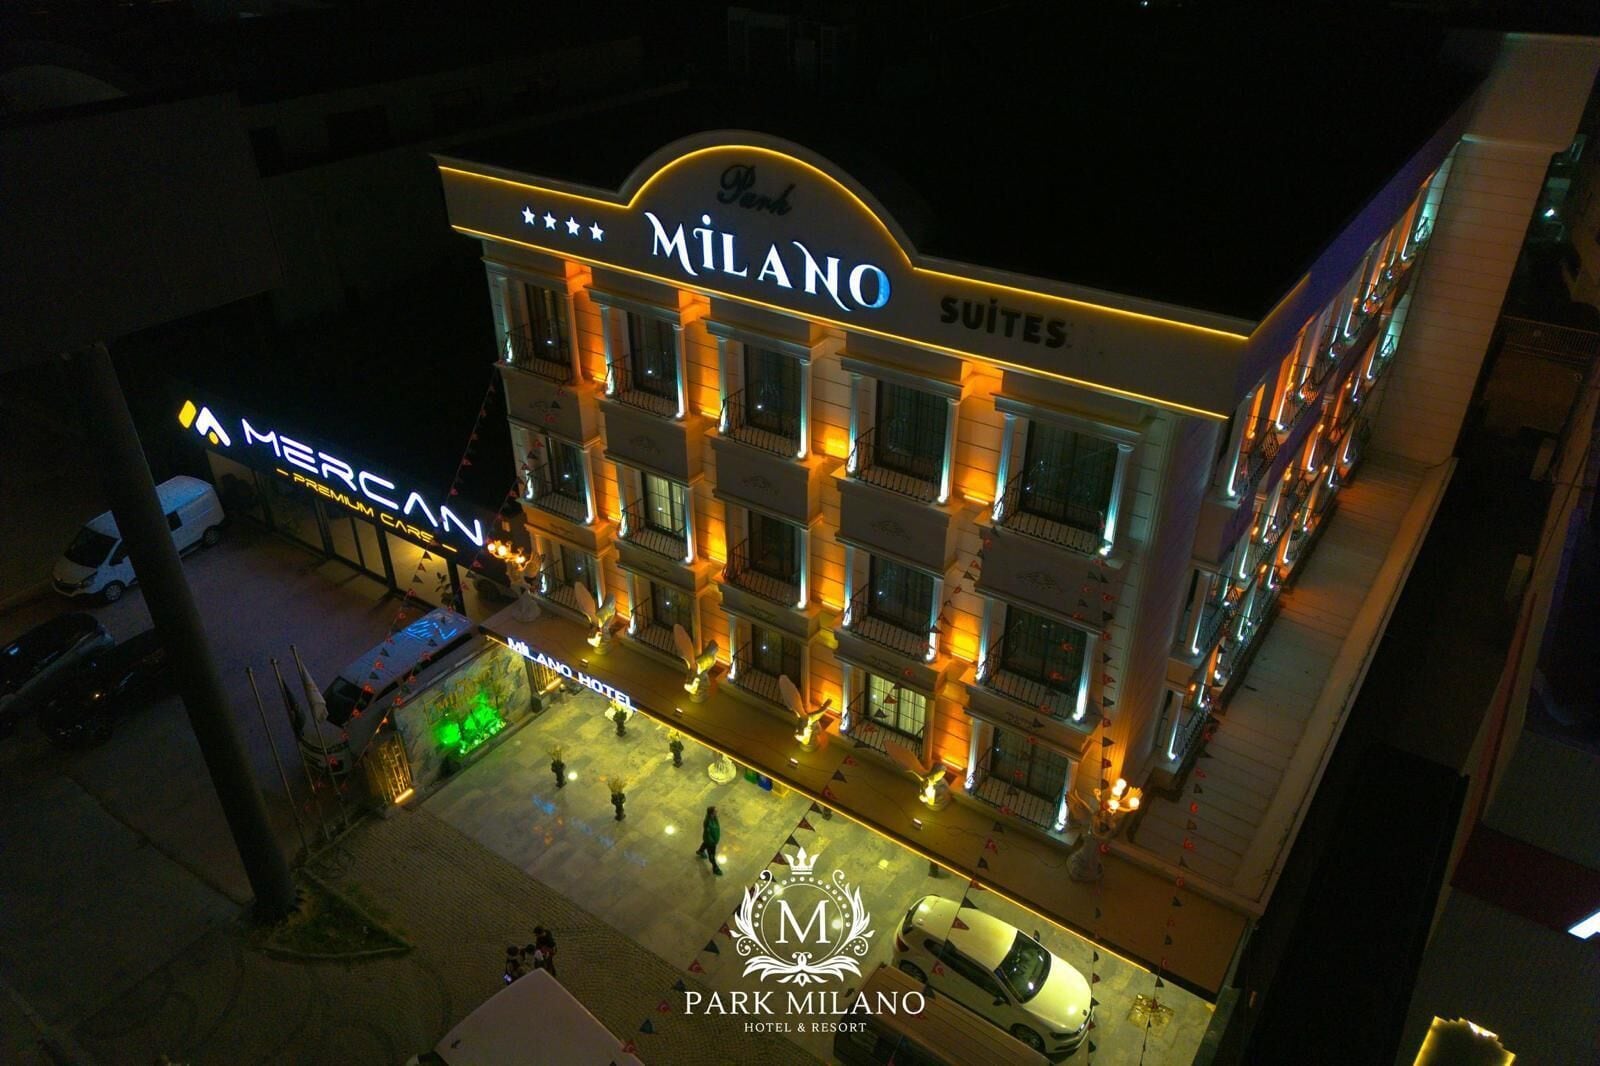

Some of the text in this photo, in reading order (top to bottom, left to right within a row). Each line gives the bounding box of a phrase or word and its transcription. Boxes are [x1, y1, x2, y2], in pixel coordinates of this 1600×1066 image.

[717, 164, 796, 216] Park
[241, 417, 484, 547] MERCAN
[293, 473, 435, 543] PREMIUM CARS
[577, 671, 640, 713] HOTEL
